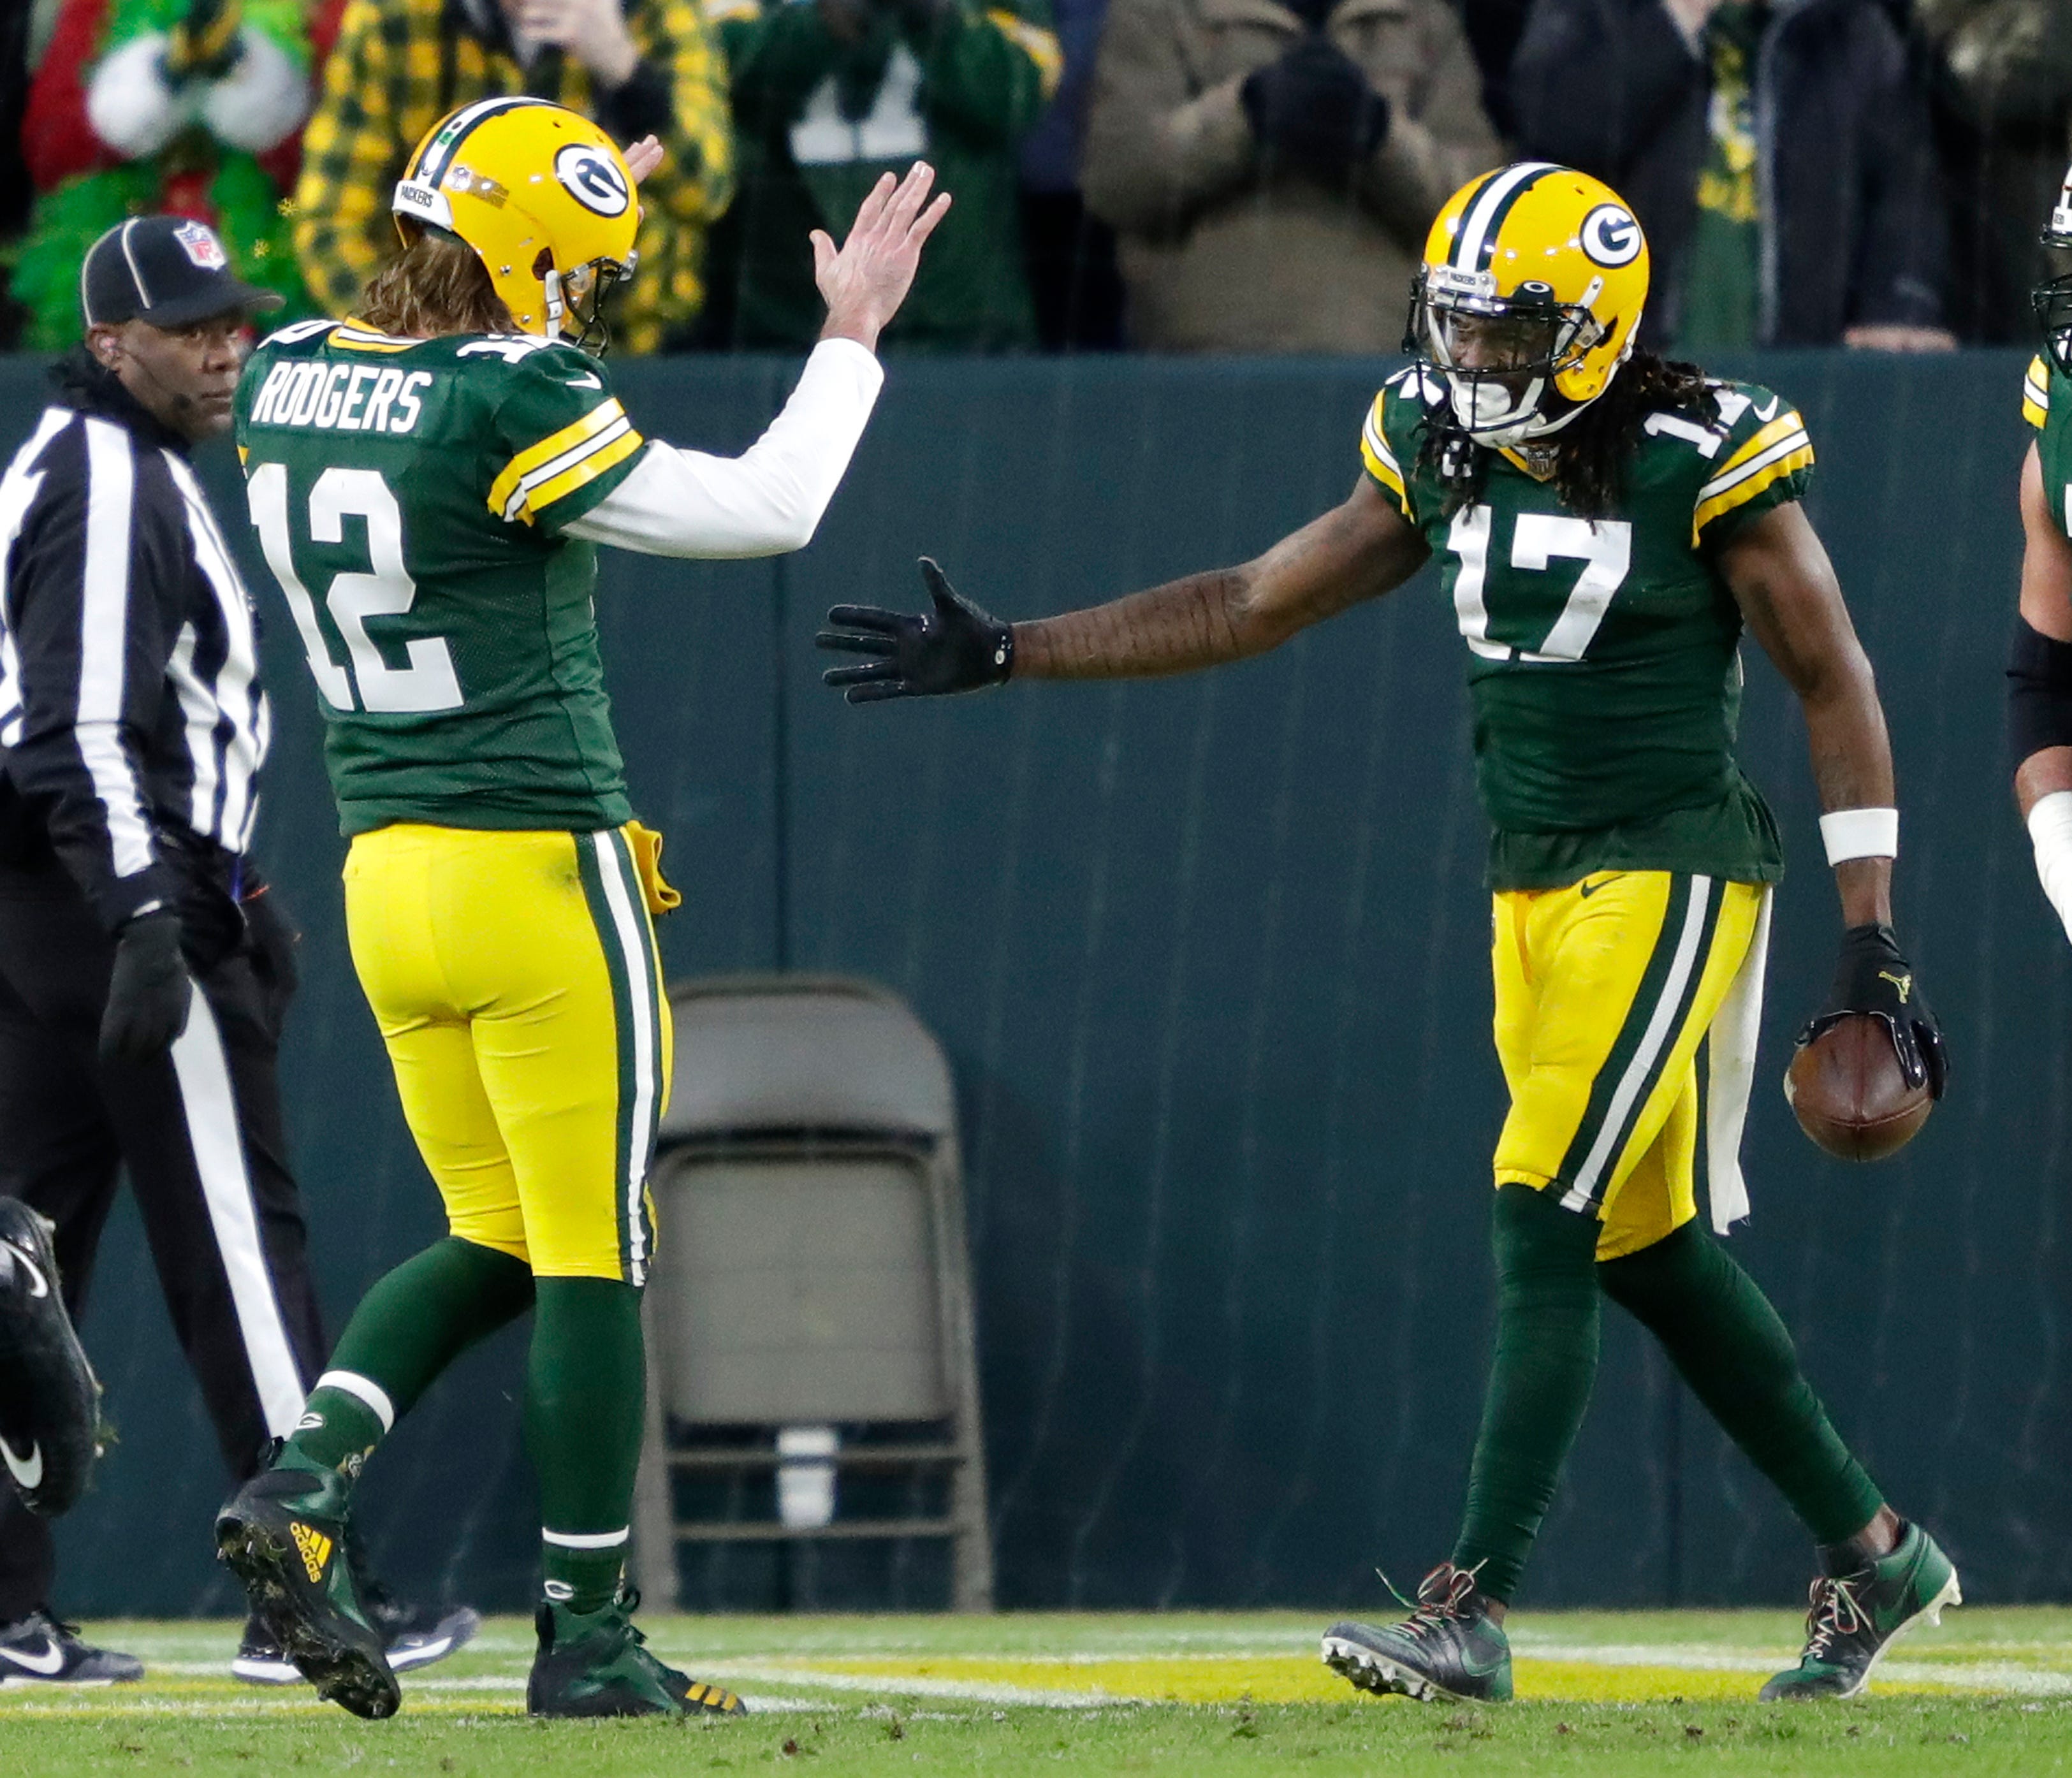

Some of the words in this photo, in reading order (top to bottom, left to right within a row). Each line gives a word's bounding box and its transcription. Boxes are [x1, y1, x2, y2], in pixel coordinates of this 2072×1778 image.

[251, 361, 432, 433] RODGERS
[247, 462, 465, 713] 12
[1447, 505, 1632, 662] 17
[290, 1522, 322, 1584] adidas
